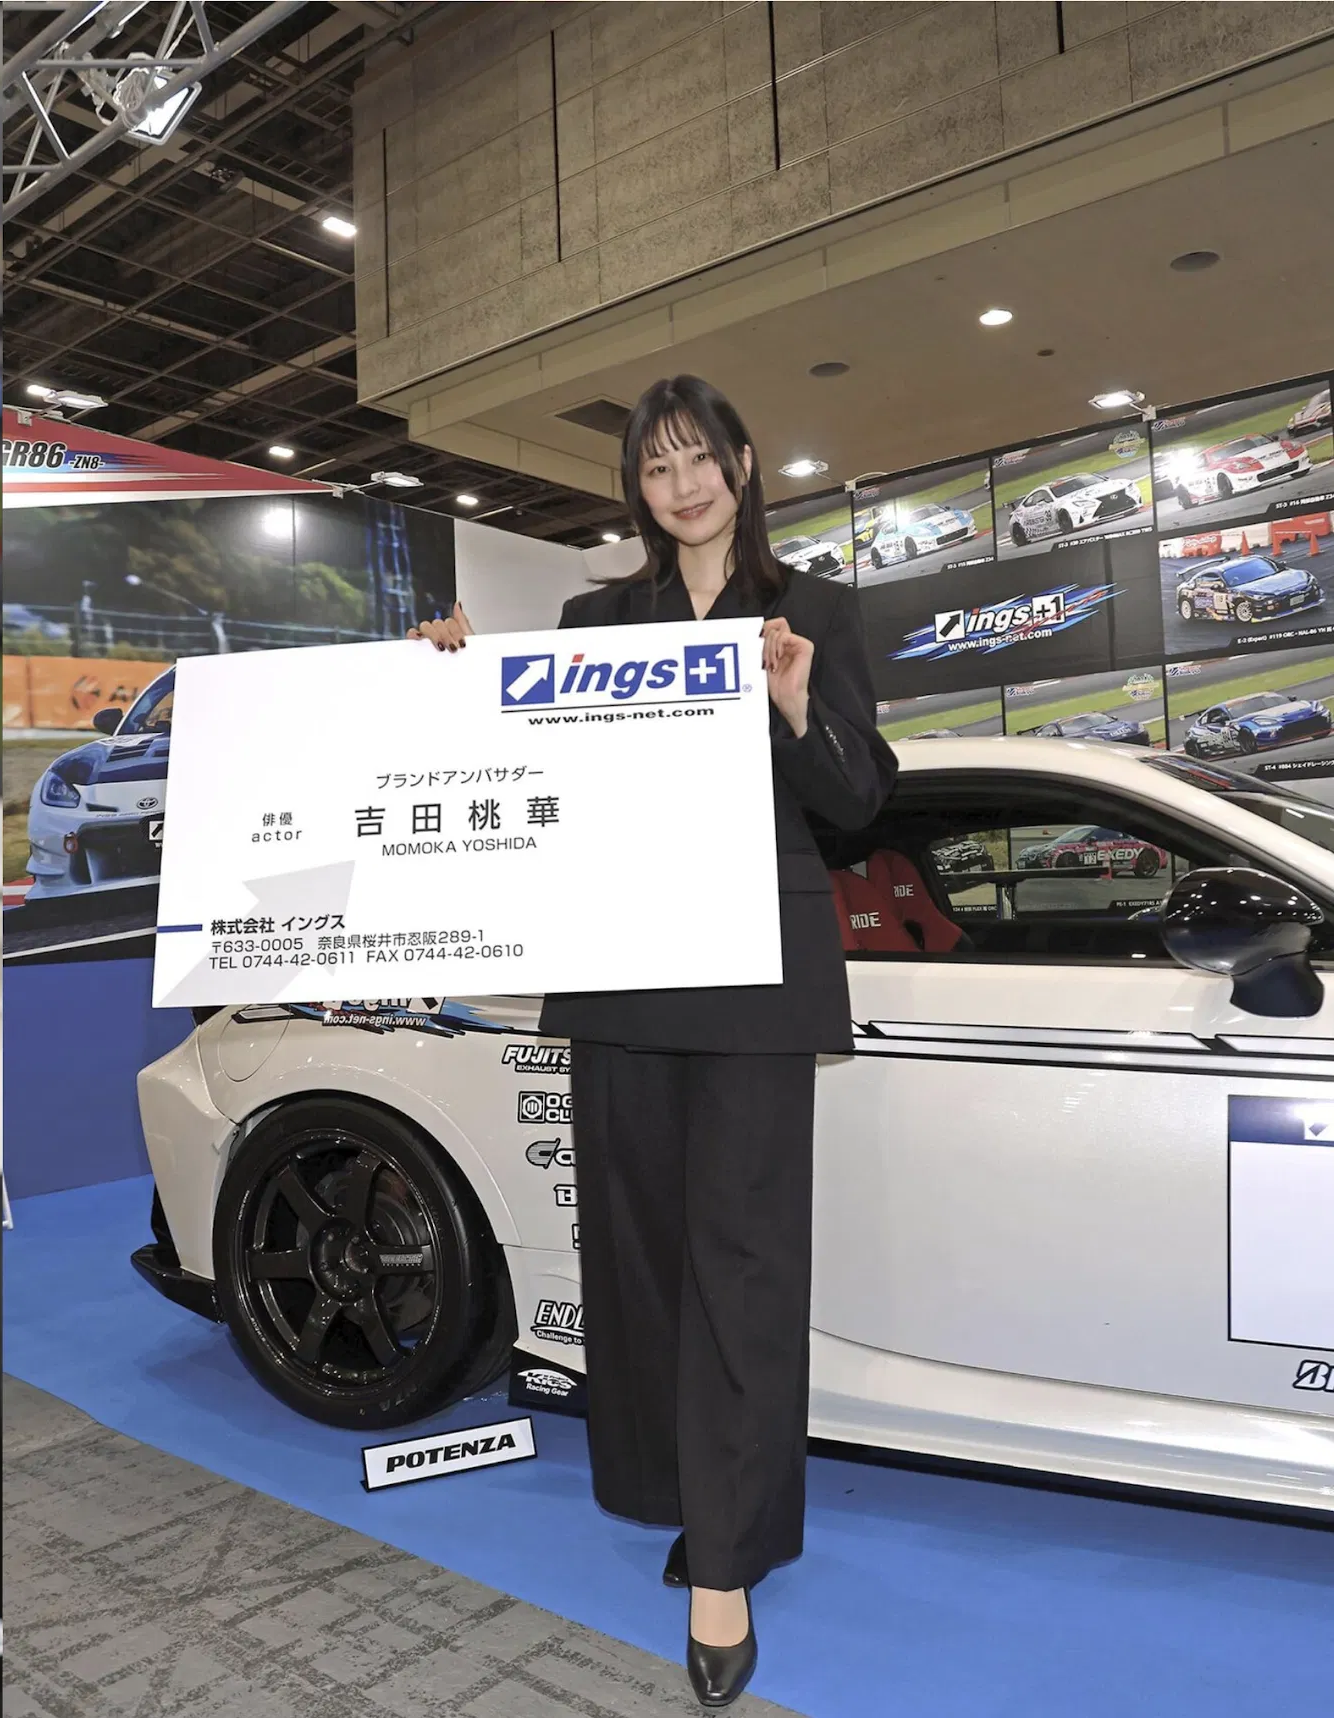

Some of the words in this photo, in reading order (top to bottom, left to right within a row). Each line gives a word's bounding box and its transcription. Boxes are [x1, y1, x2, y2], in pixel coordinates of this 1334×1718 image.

[528, 706, 715, 725] www.ings-net.com
[377, 765, 544, 789] ブランドアンバサダー
[262, 812, 293, 827] 俳優
[251, 828, 303, 843] actor
[382, 841, 457, 856] MOMOKA
[463, 836, 537, 852] YOSHIDA
[1097, 847, 1144, 861] EXEDY
[210, 918, 275, 935] 株式会社
[281, 914, 346, 931] イングス
[209, 956, 237, 970] TEL
[242, 951, 355, 969] 0744-42-0611
[367, 950, 399, 964] FAX
[404, 944, 524, 962] 0744-42-0610
[516, 1065, 558, 1073] EXHAUST
[546, 1109, 573, 1122] CL
[536, 1330, 573, 1343] Challenge
[526, 1383, 550, 1395] Racing
[551, 1387, 569, 1397] Gear
[386, 1433, 516, 1474] POTENZA
